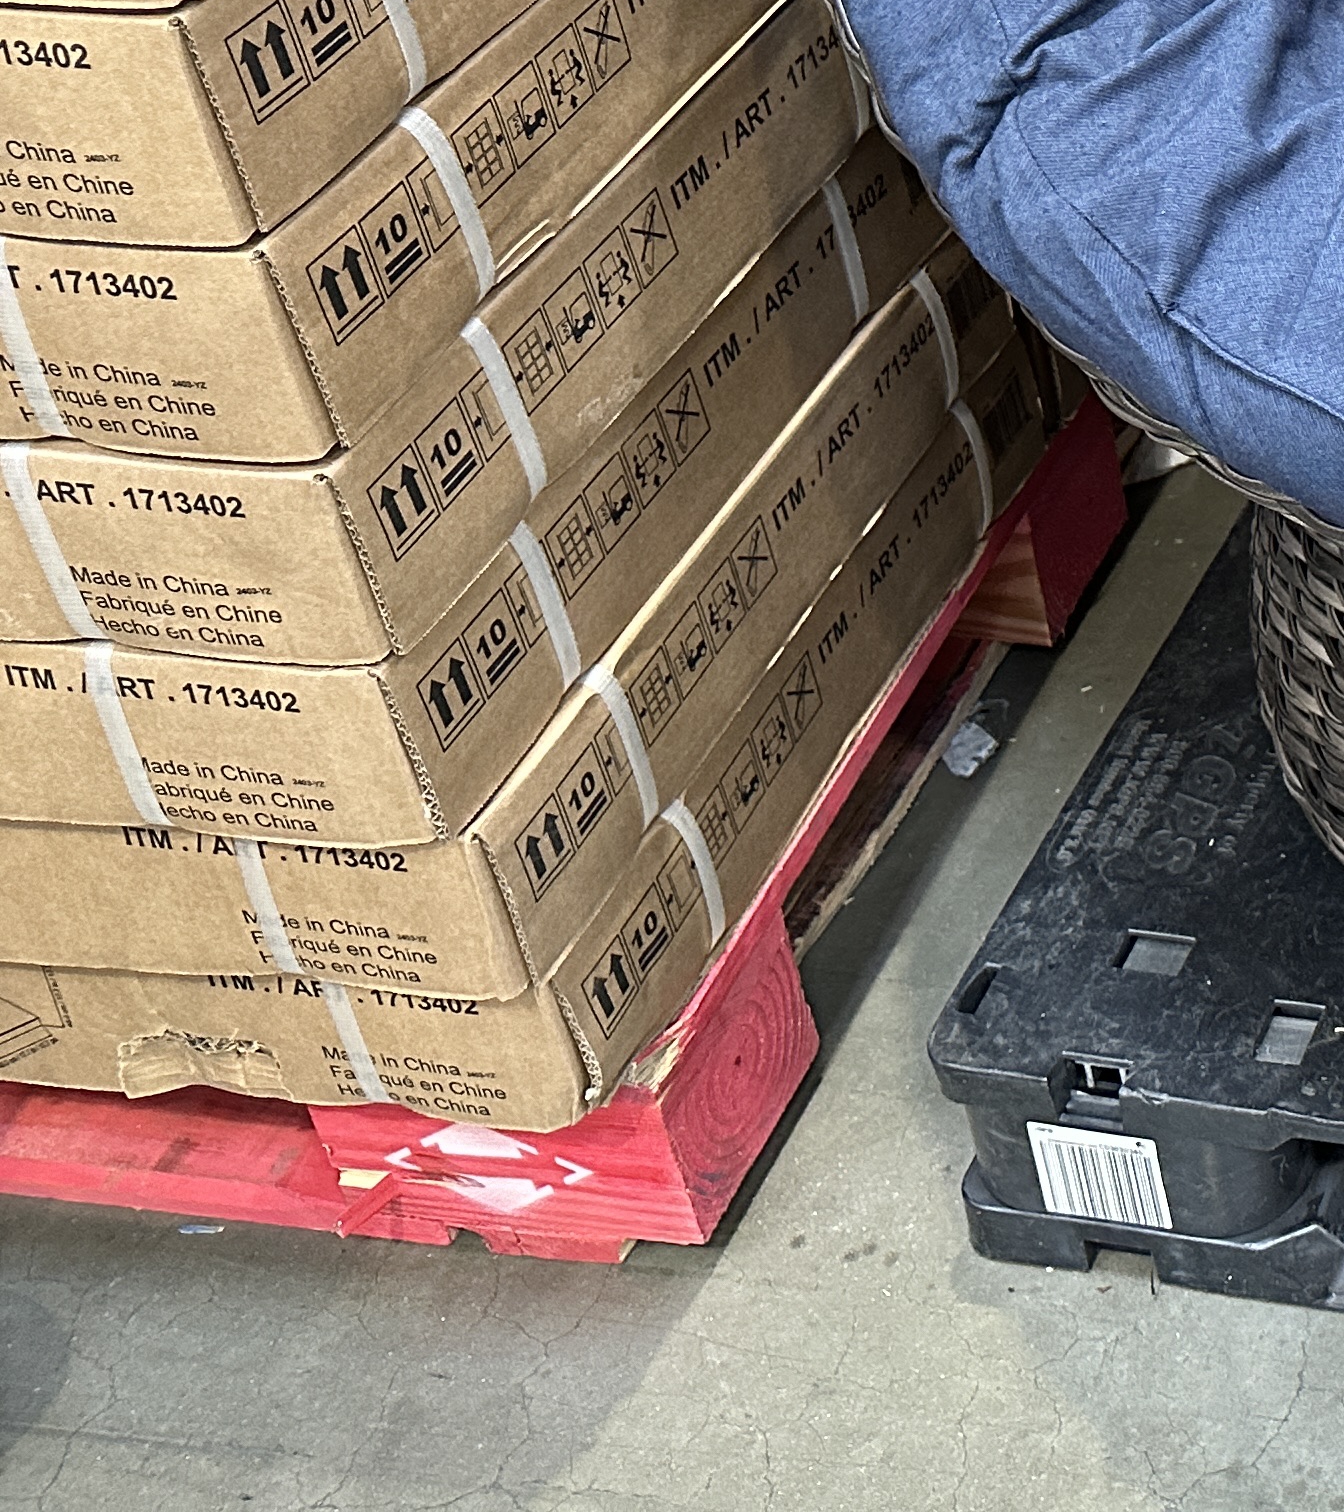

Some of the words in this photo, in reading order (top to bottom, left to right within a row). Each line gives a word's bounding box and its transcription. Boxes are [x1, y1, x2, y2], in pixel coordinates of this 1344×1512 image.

[5, 140, 77, 164] China
[27, 174, 59, 191] en
[62, 173, 134, 196] Chine
[11, 200, 42, 218] en
[45, 199, 118, 224] China
[49, 268, 178, 301] 1713402
[873, 313, 937, 399] 1713402
[429, 428, 462, 471] 10
[912, 441, 975, 529] 1713402
[122, 487, 247, 519] 1713402
[68, 565, 132, 588] Made
[134, 571, 158, 591] in
[162, 575, 230, 597] China
[79, 590, 176, 616] Fabriqué
[181, 605, 211, 620] en
[214, 604, 283, 624] Chine
[90, 613, 160, 637] Hecho
[165, 626, 195, 642] en
[197, 626, 265, 648] China
[182, 682, 301, 714] 1713402
[293, 843, 409, 873] 1713402
[630, 910, 658, 950] 10
